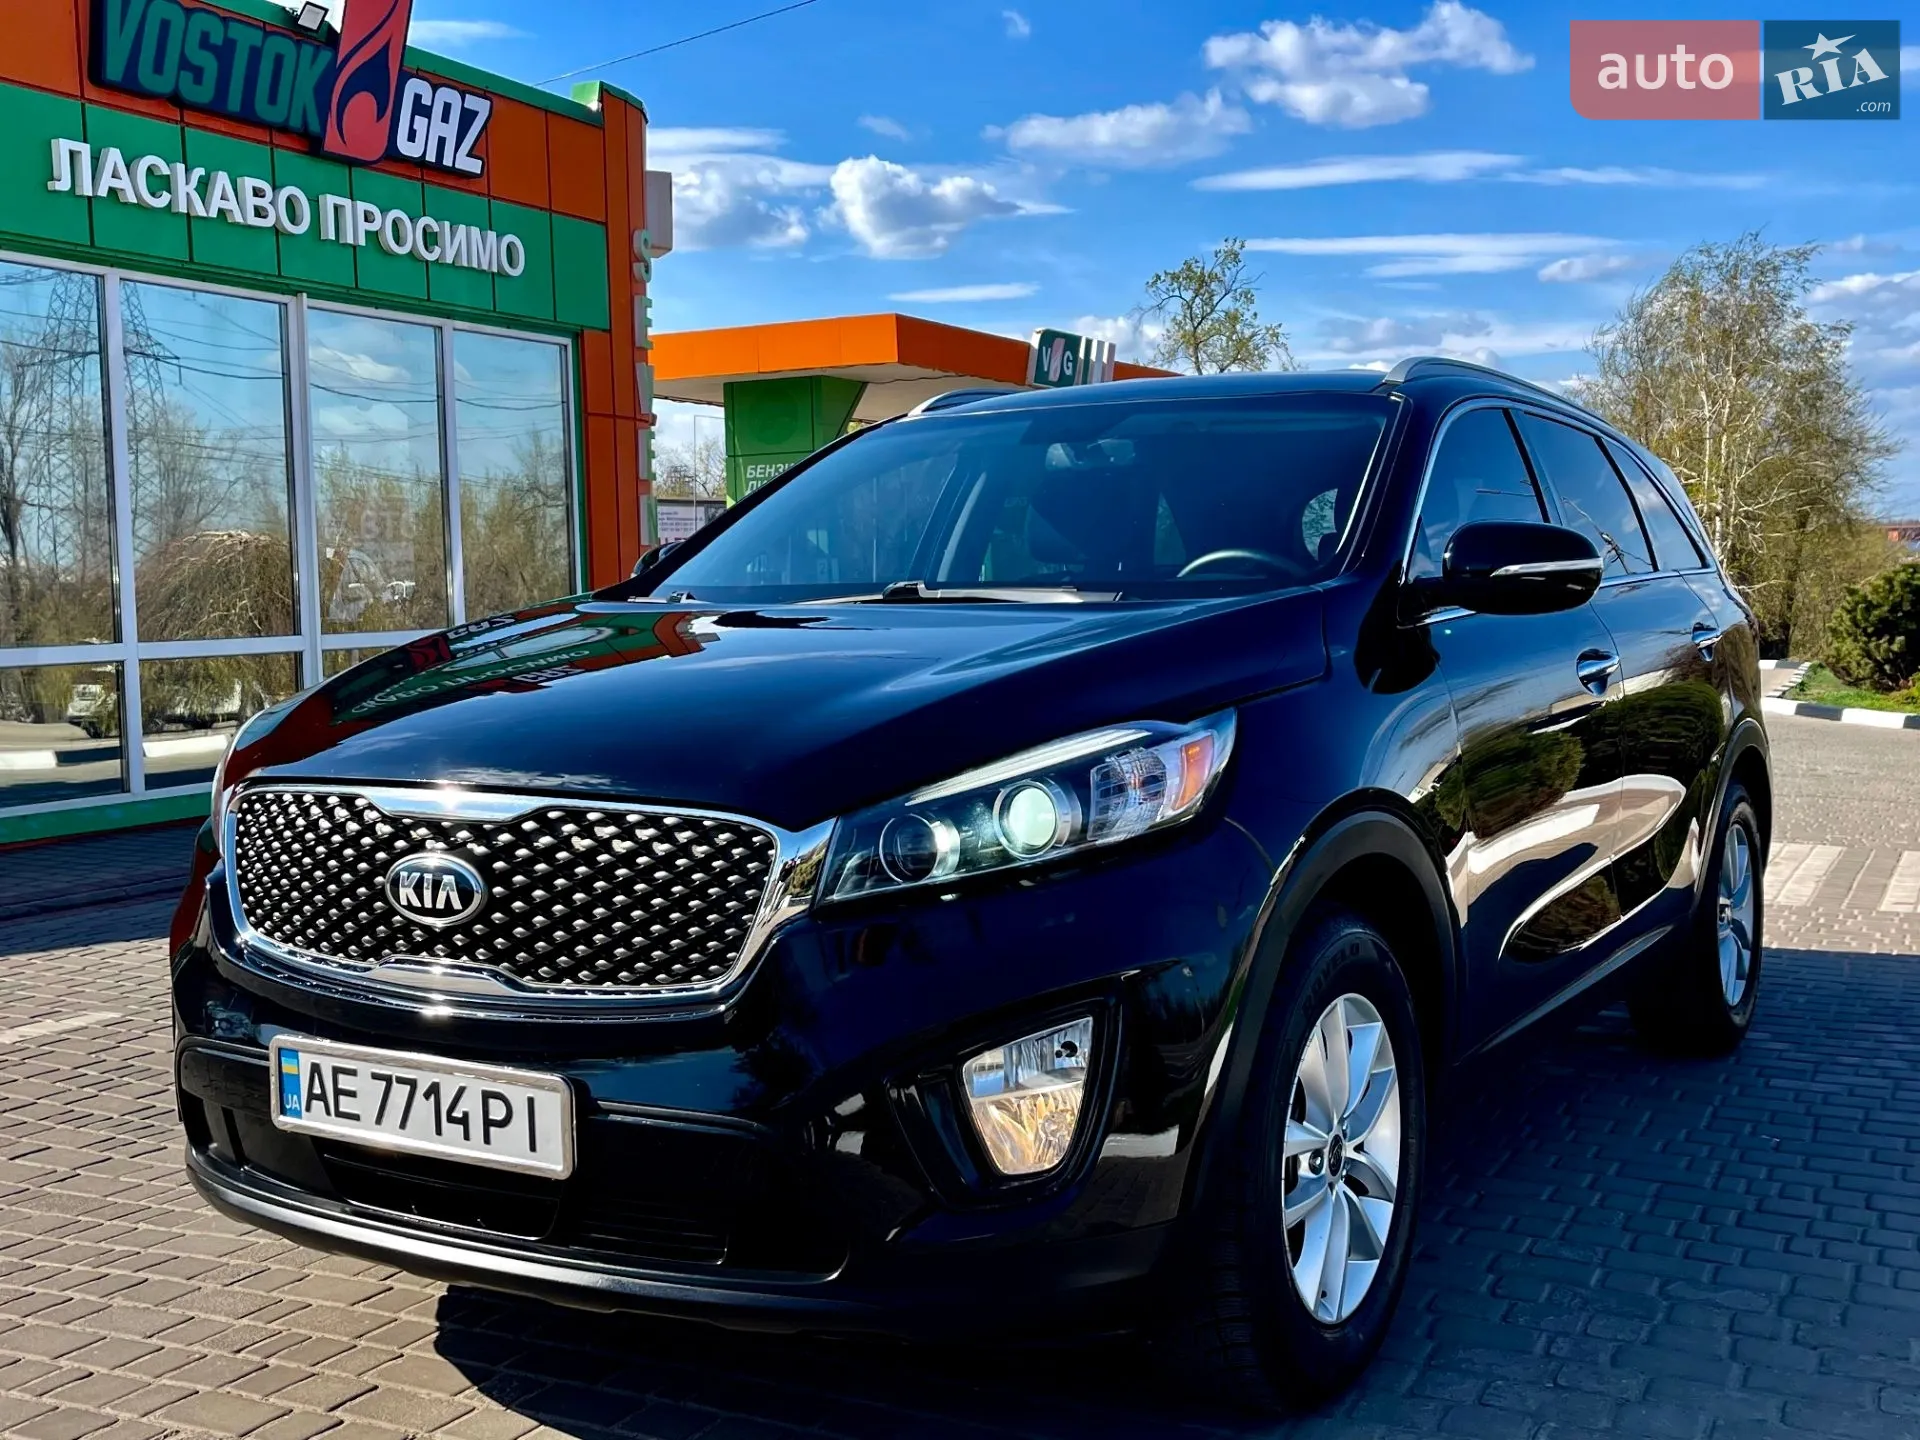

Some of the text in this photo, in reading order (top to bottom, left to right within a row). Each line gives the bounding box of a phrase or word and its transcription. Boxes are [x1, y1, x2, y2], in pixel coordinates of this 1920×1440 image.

[103, 0, 492, 173] VOSTOK GAZ
[47, 137, 524, 277] ЛАСКАВО ПРОСИМО
[399, 871, 462, 910] KIA
